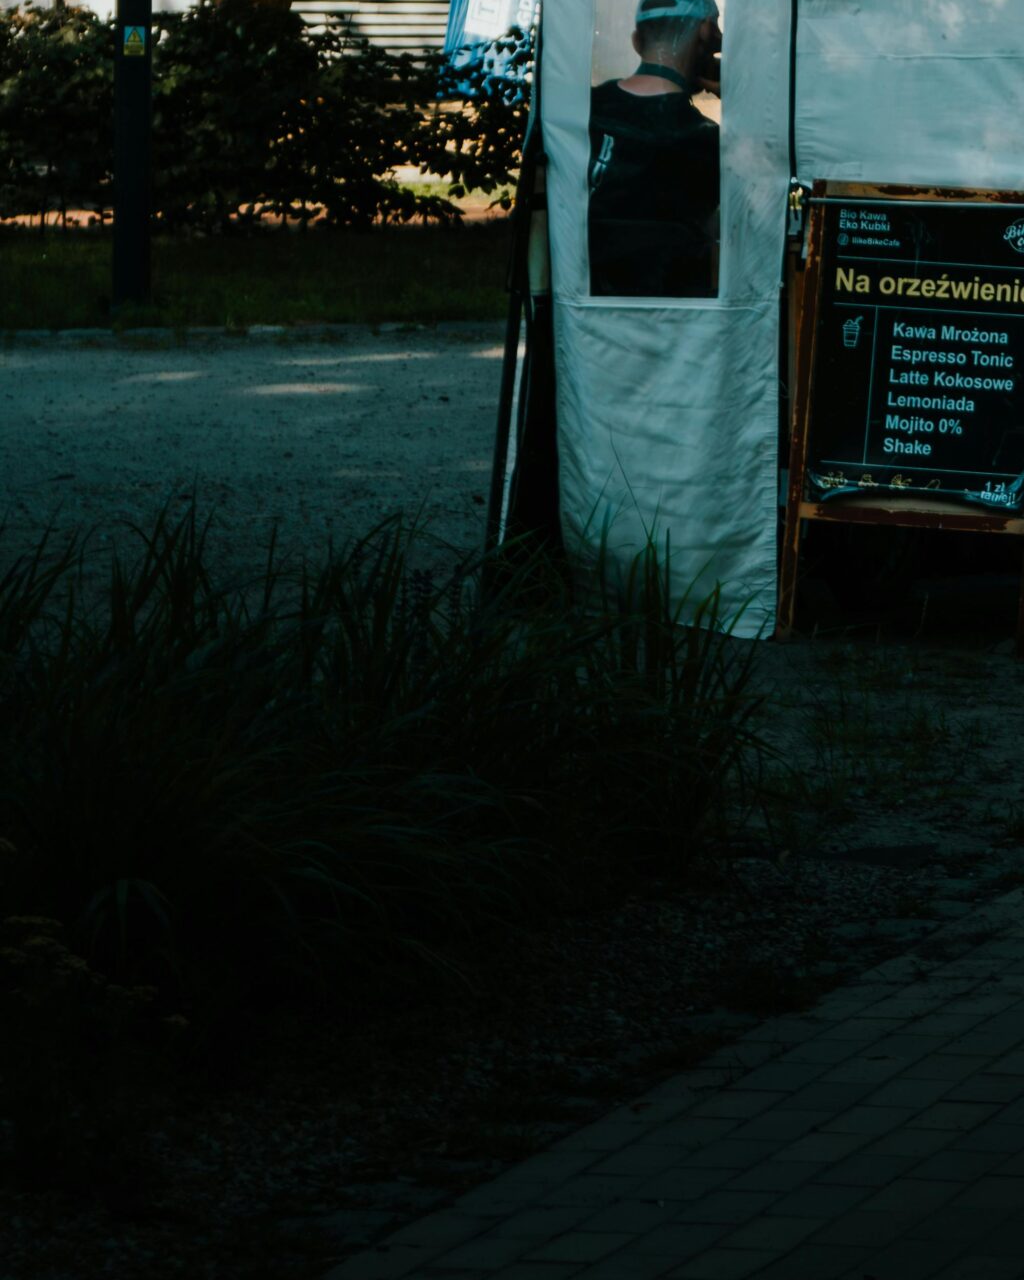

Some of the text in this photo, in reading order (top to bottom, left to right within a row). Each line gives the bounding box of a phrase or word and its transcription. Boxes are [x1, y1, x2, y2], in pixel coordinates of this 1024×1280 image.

[840, 208, 887, 221] Bio Kawa
[839, 219, 891, 232] Eko Kubki
[836, 267, 871, 294] Na
[893, 322, 1009, 344] Kawa Mrożona
[891, 345, 1014, 368] Espresso Tonic
[889, 368, 1014, 391] Latte Kokosowe
[887, 391, 975, 412] Lemoniada
[885, 414, 963, 435] Mojito 0%
[883, 437, 932, 455] Shake
[985, 481, 991, 492] 1
